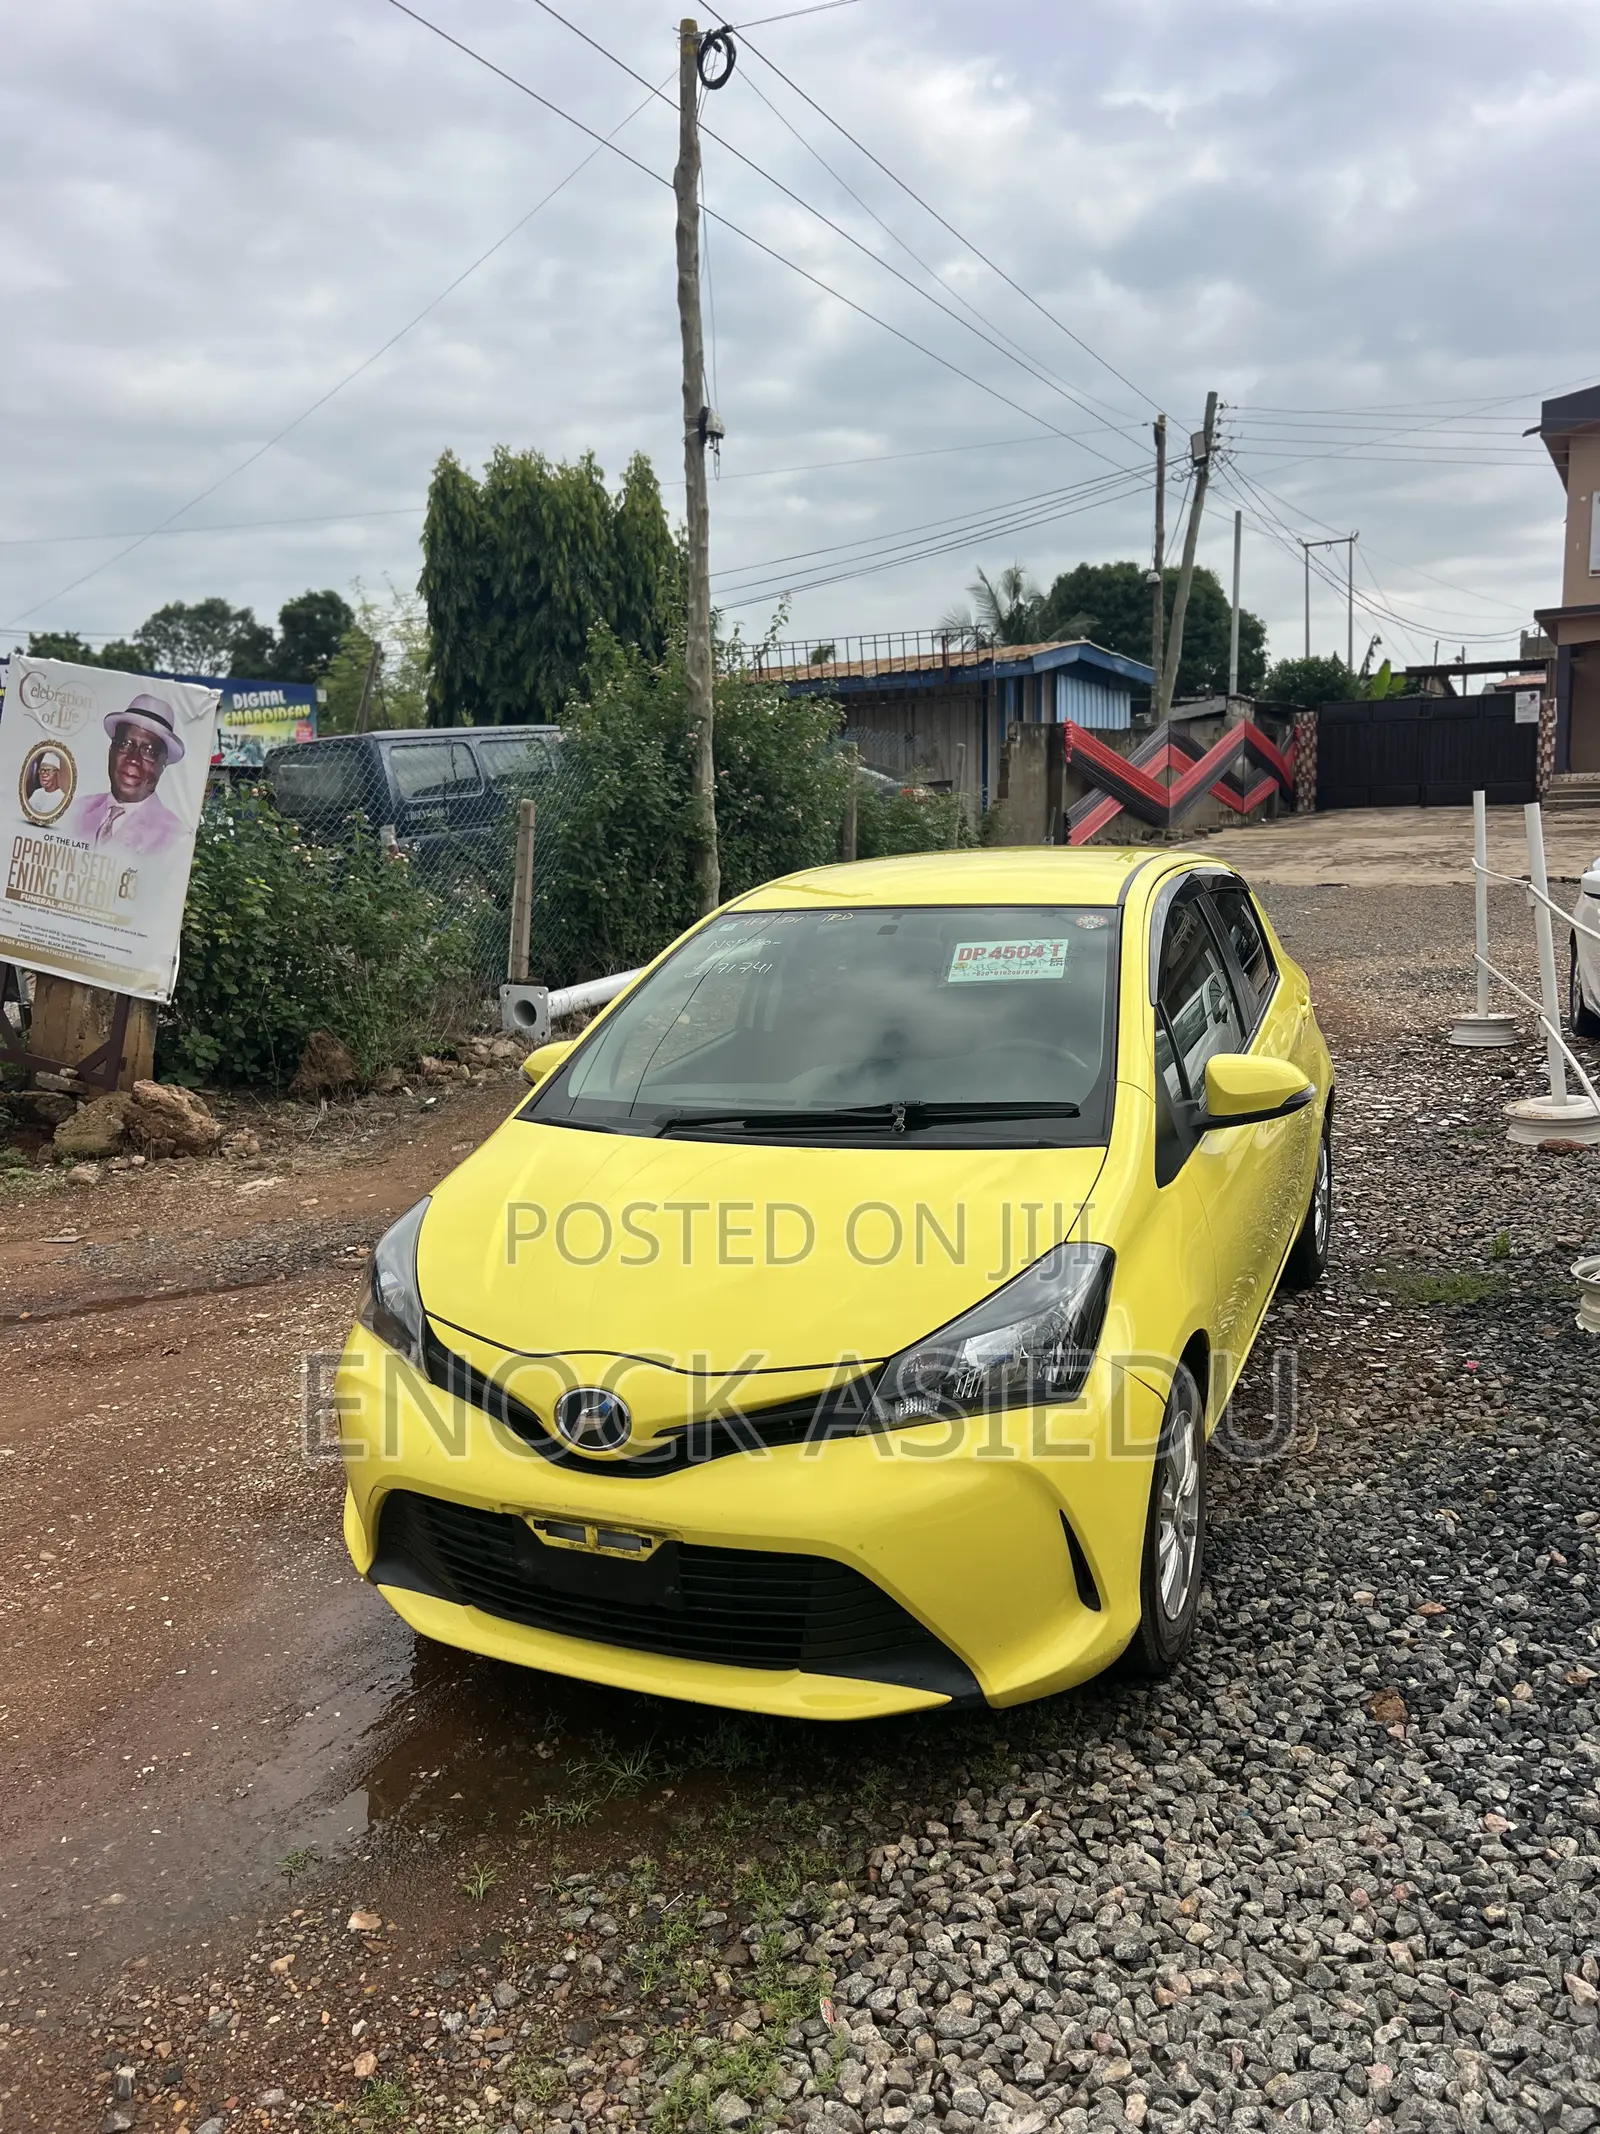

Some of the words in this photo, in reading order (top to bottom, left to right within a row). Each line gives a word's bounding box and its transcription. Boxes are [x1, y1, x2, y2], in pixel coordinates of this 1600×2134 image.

[19, 671, 92, 709] Celebration
[232, 690, 286, 709] DIGITAL
[42, 711, 57, 724] of
[55, 703, 80, 730] Life
[224, 704, 311, 727] EMBROIDERY
[44, 834, 54, 842] OF
[56, 836, 70, 846] THE
[71, 840, 90, 850] LATE
[12, 835, 77, 873] OPANYIN
[80, 851, 118, 881] SETH
[7, 859, 59, 897] ENING
[118, 872, 138, 900] 83
[20, 893, 56, 907] FUNERAL
[57, 902, 116, 922] ARRANGEMENT
[16, 941, 29, 949] AND
[988, 944, 1045, 960] 4504
